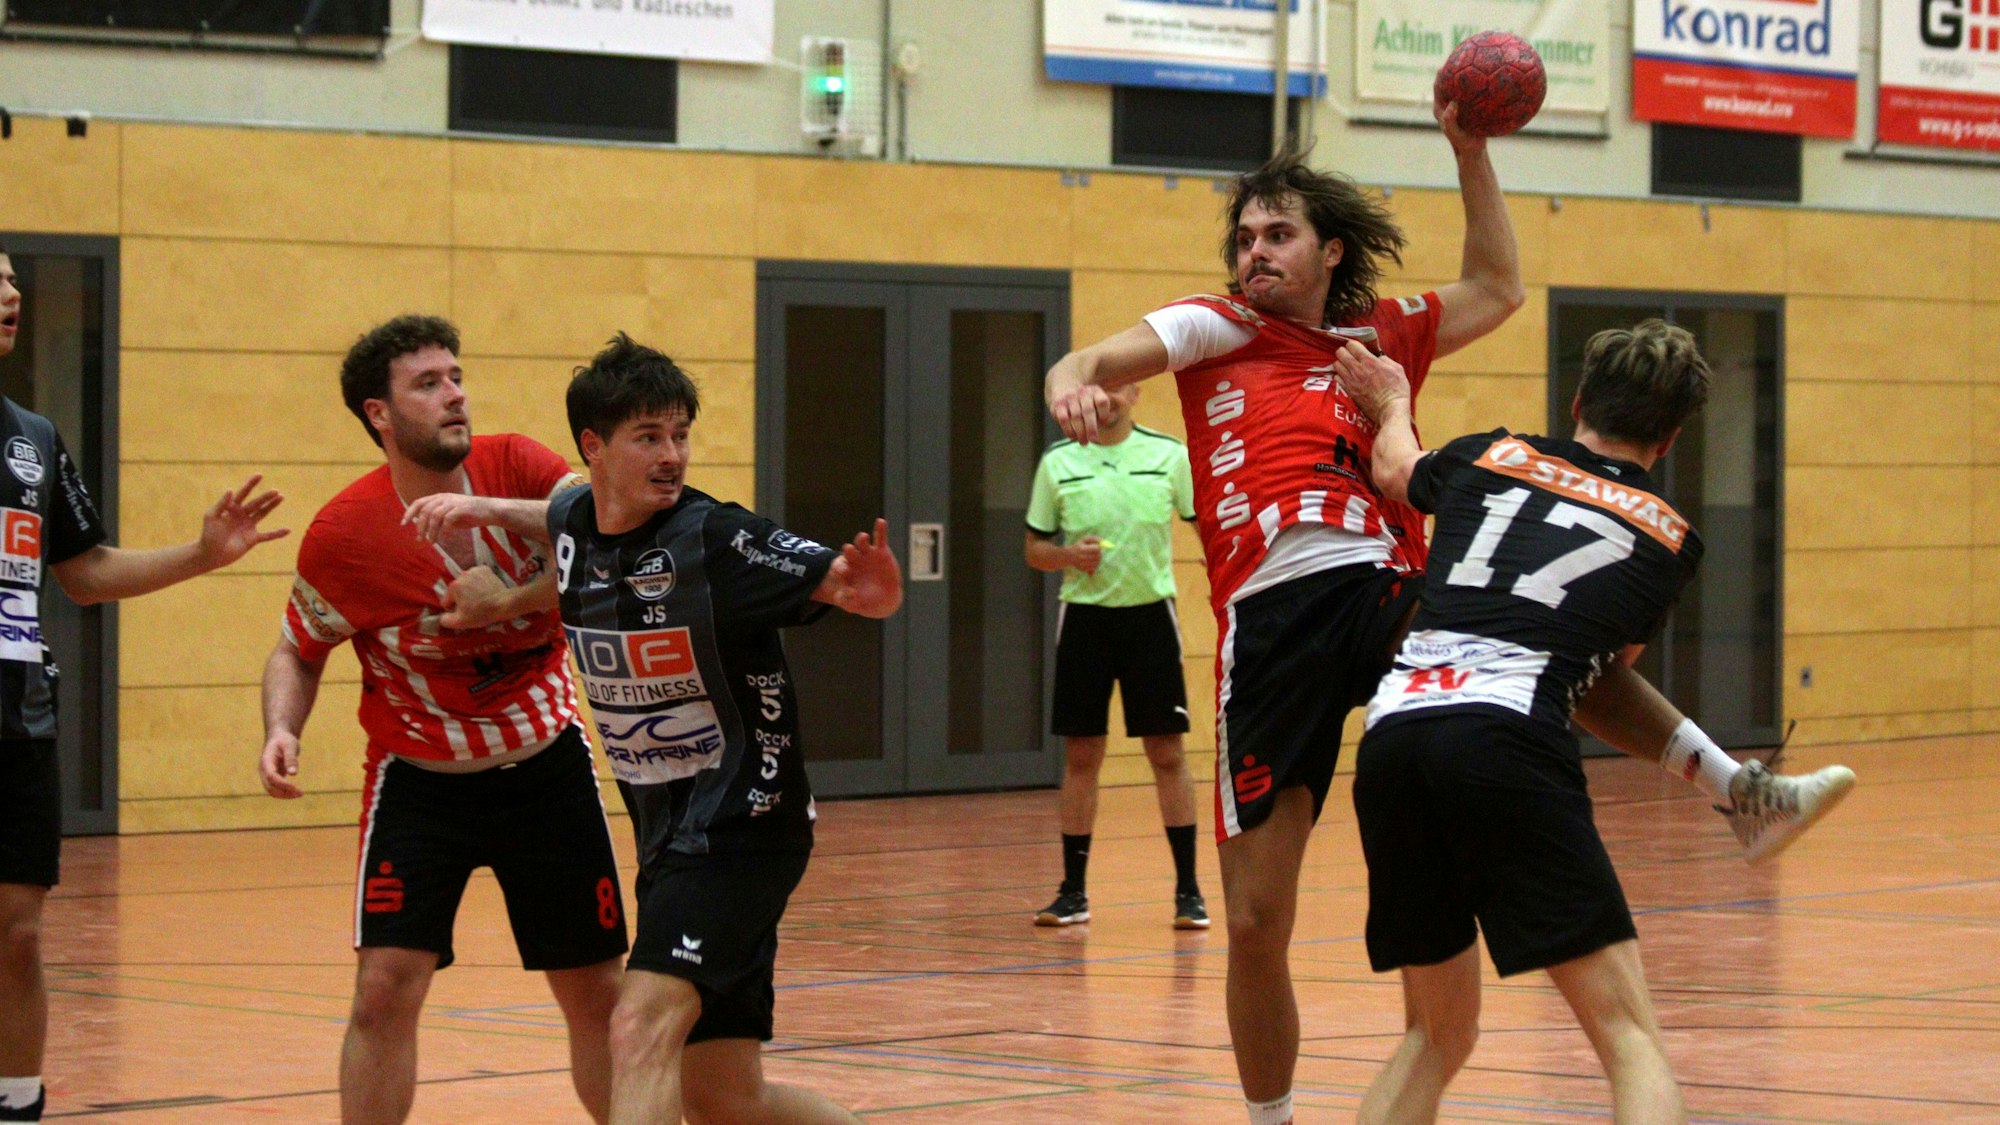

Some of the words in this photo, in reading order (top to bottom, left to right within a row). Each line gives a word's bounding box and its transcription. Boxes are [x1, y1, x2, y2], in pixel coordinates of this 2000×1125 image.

[1374, 18, 1443, 54] Achim
[1663, 0, 1831, 56] konrad
[12, 441, 38, 463] BTB
[21, 489, 39, 507] JS
[1529, 460, 1682, 542] STAWAG
[1446, 487, 1636, 609] 17
[642, 605, 667, 624] JS
[601, 684, 618, 702] OF
[622, 679, 701, 702] FITNESS
[746, 671, 785, 688] DOCK
[760, 688, 782, 721] 5
[755, 728, 791, 747] DOCK
[760, 746, 780, 780] 5
[596, 876, 618, 929] 8
[671, 948, 702, 964] erima
